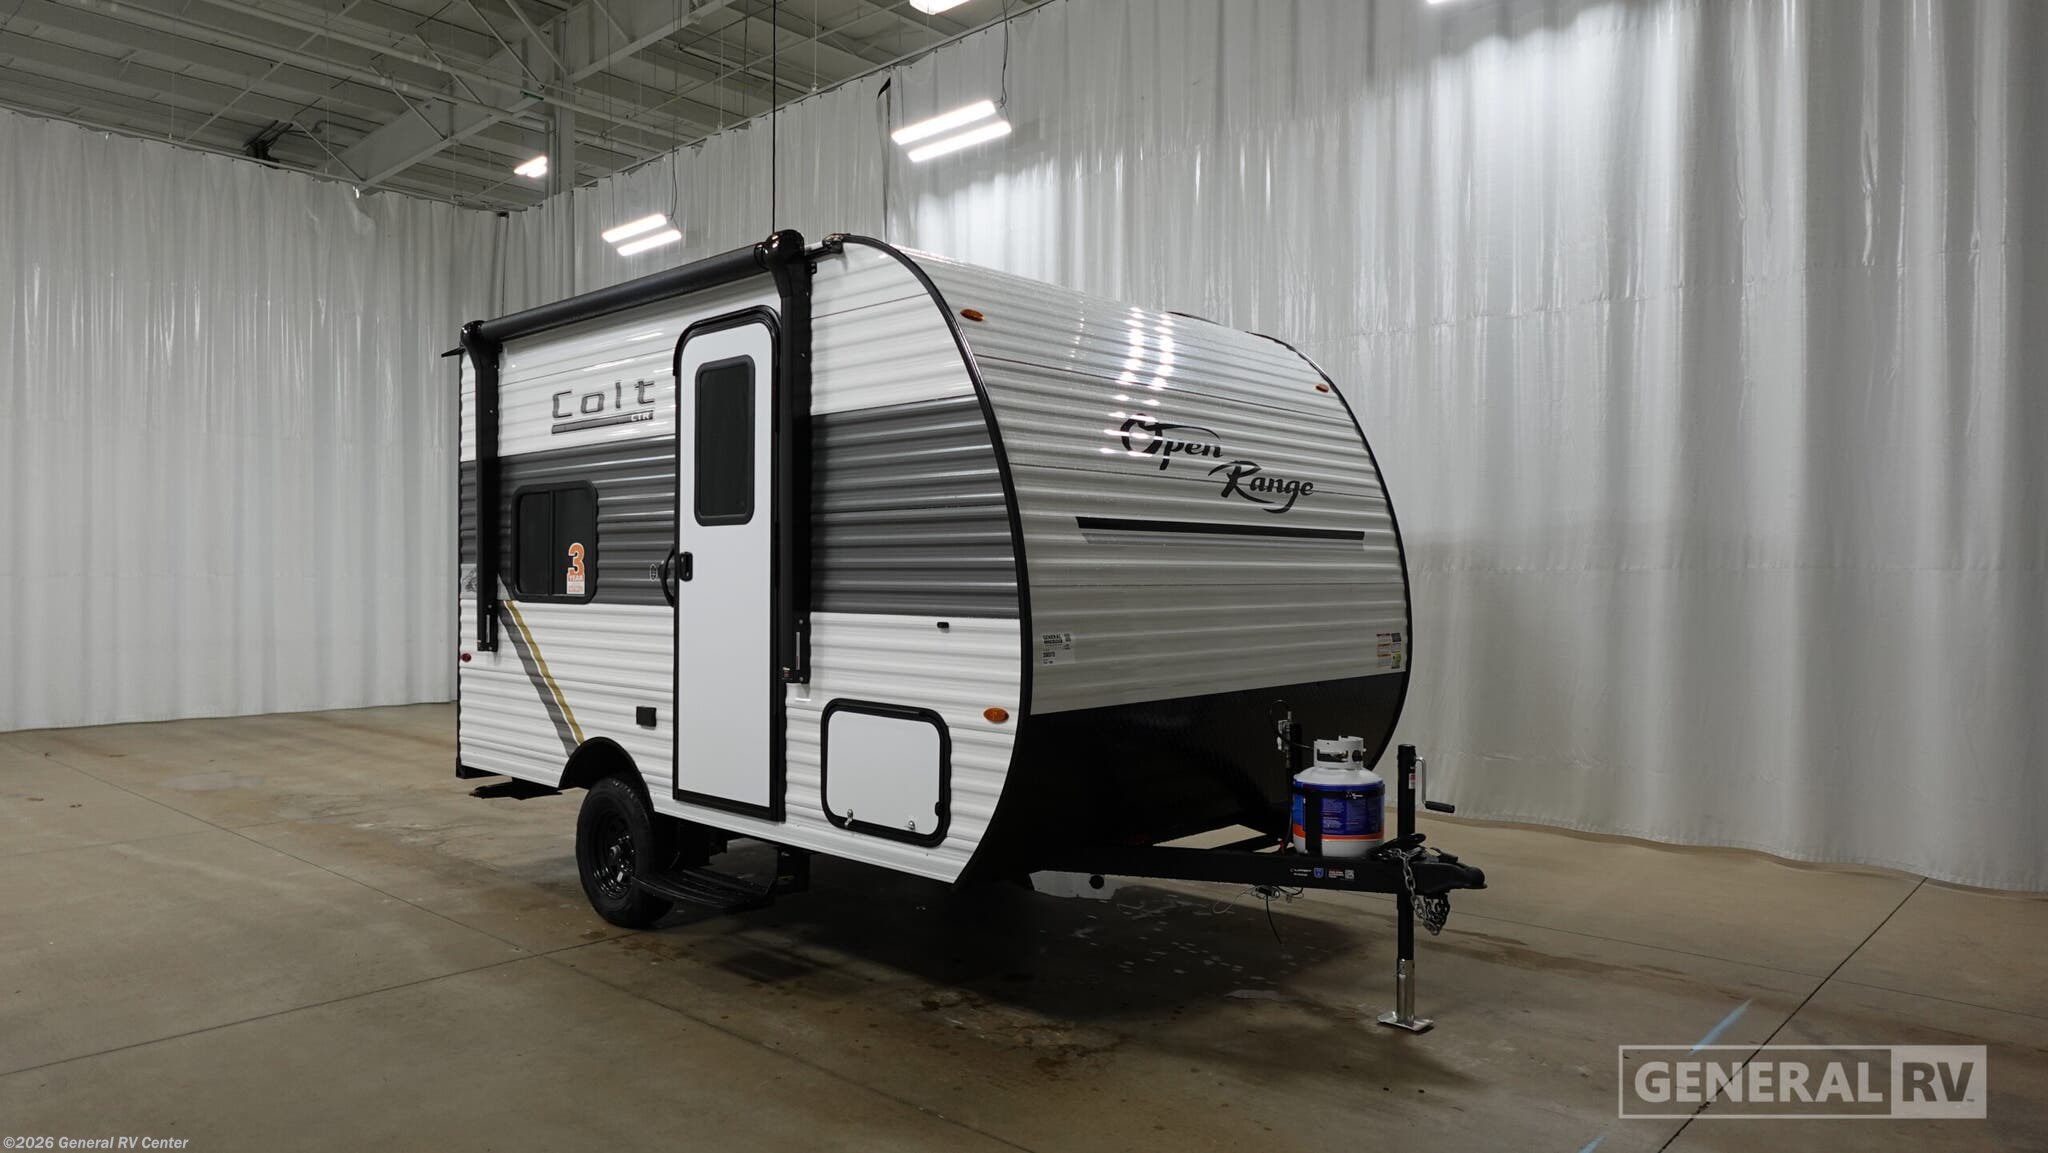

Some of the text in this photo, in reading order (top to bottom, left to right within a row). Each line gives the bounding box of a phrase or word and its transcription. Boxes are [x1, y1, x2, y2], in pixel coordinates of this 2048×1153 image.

[552, 381, 655, 418] Colt
[1120, 413, 1223, 471] Open
[1208, 460, 1314, 514] Range
[568, 542, 585, 576] 3
